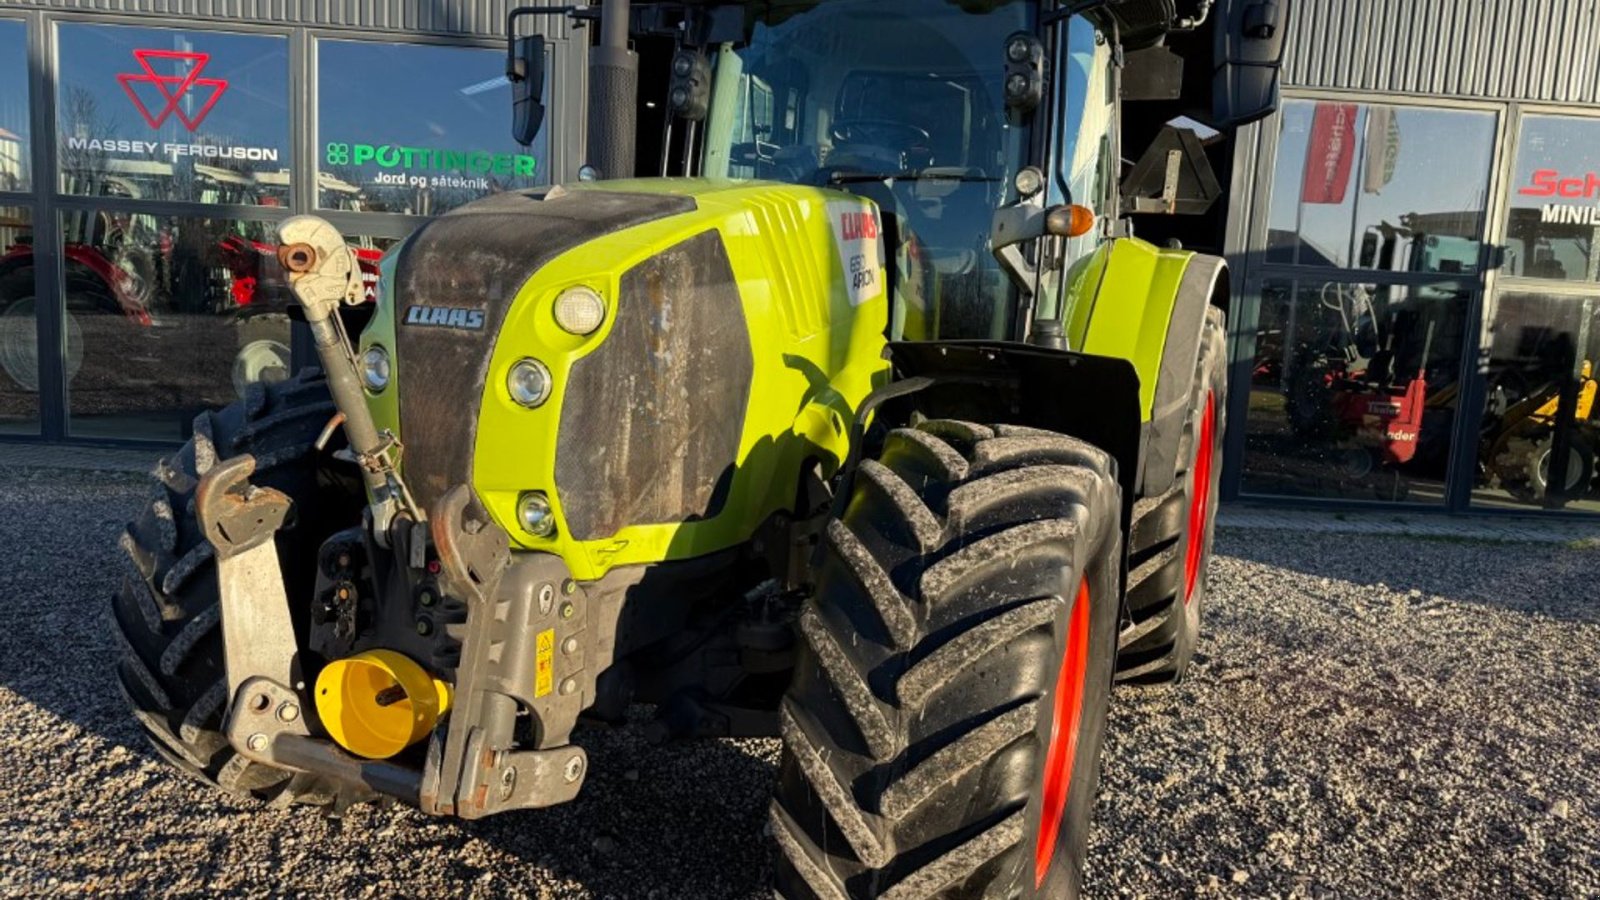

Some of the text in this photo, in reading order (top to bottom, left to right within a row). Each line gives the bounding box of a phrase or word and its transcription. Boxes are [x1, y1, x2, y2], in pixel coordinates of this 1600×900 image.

[68, 137, 278, 161] MASSEY FERGUSON
[374, 171, 489, 190] Jord og såteknik
[841, 212, 877, 240] CLAAS
[1541, 204, 1600, 225] MINIL
[406, 305, 485, 329] CLAAS
